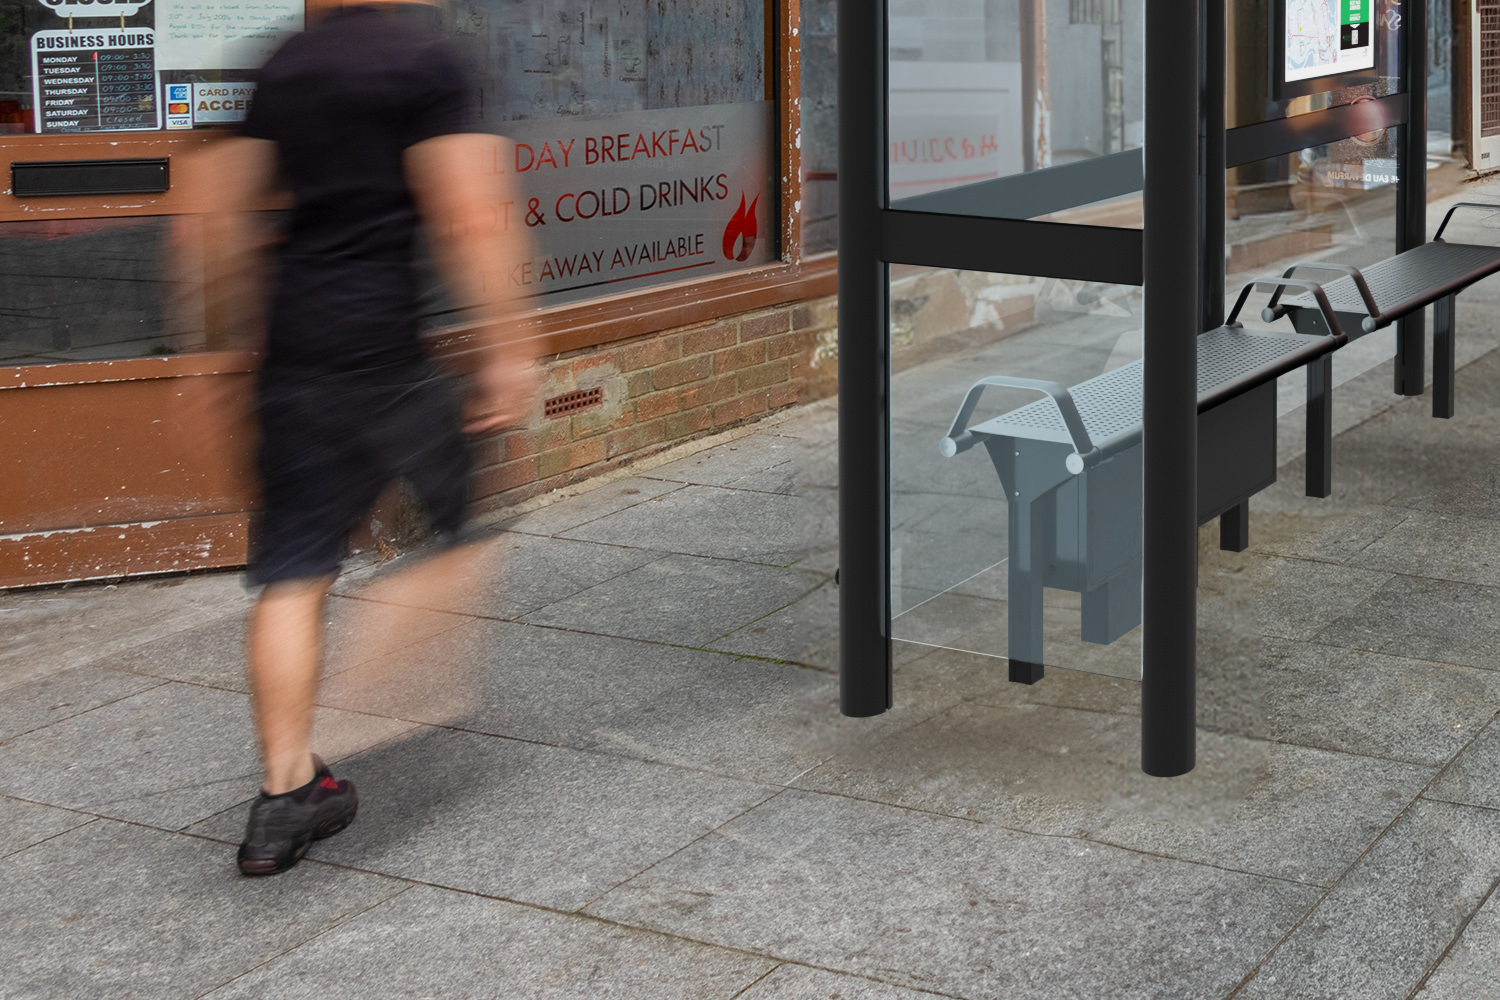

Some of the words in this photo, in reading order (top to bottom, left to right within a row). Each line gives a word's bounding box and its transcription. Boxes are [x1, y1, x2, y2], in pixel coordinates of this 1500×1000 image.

[37, 35, 104, 49] BUSINESS
[108, 34, 154, 46] HOURS
[199, 88, 229, 96] CARD
[46, 120, 80, 128] SUNDAY
[514, 138, 575, 173] DAY
[584, 124, 725, 165] BREAKFAST
[525, 198, 546, 227] &
[555, 187, 631, 223] COLD
[640, 173, 729, 212] DRINKS
[478, 261, 532, 293] TKE
[538, 250, 605, 282] AWAY
[610, 234, 704, 270] AVAILABLE
